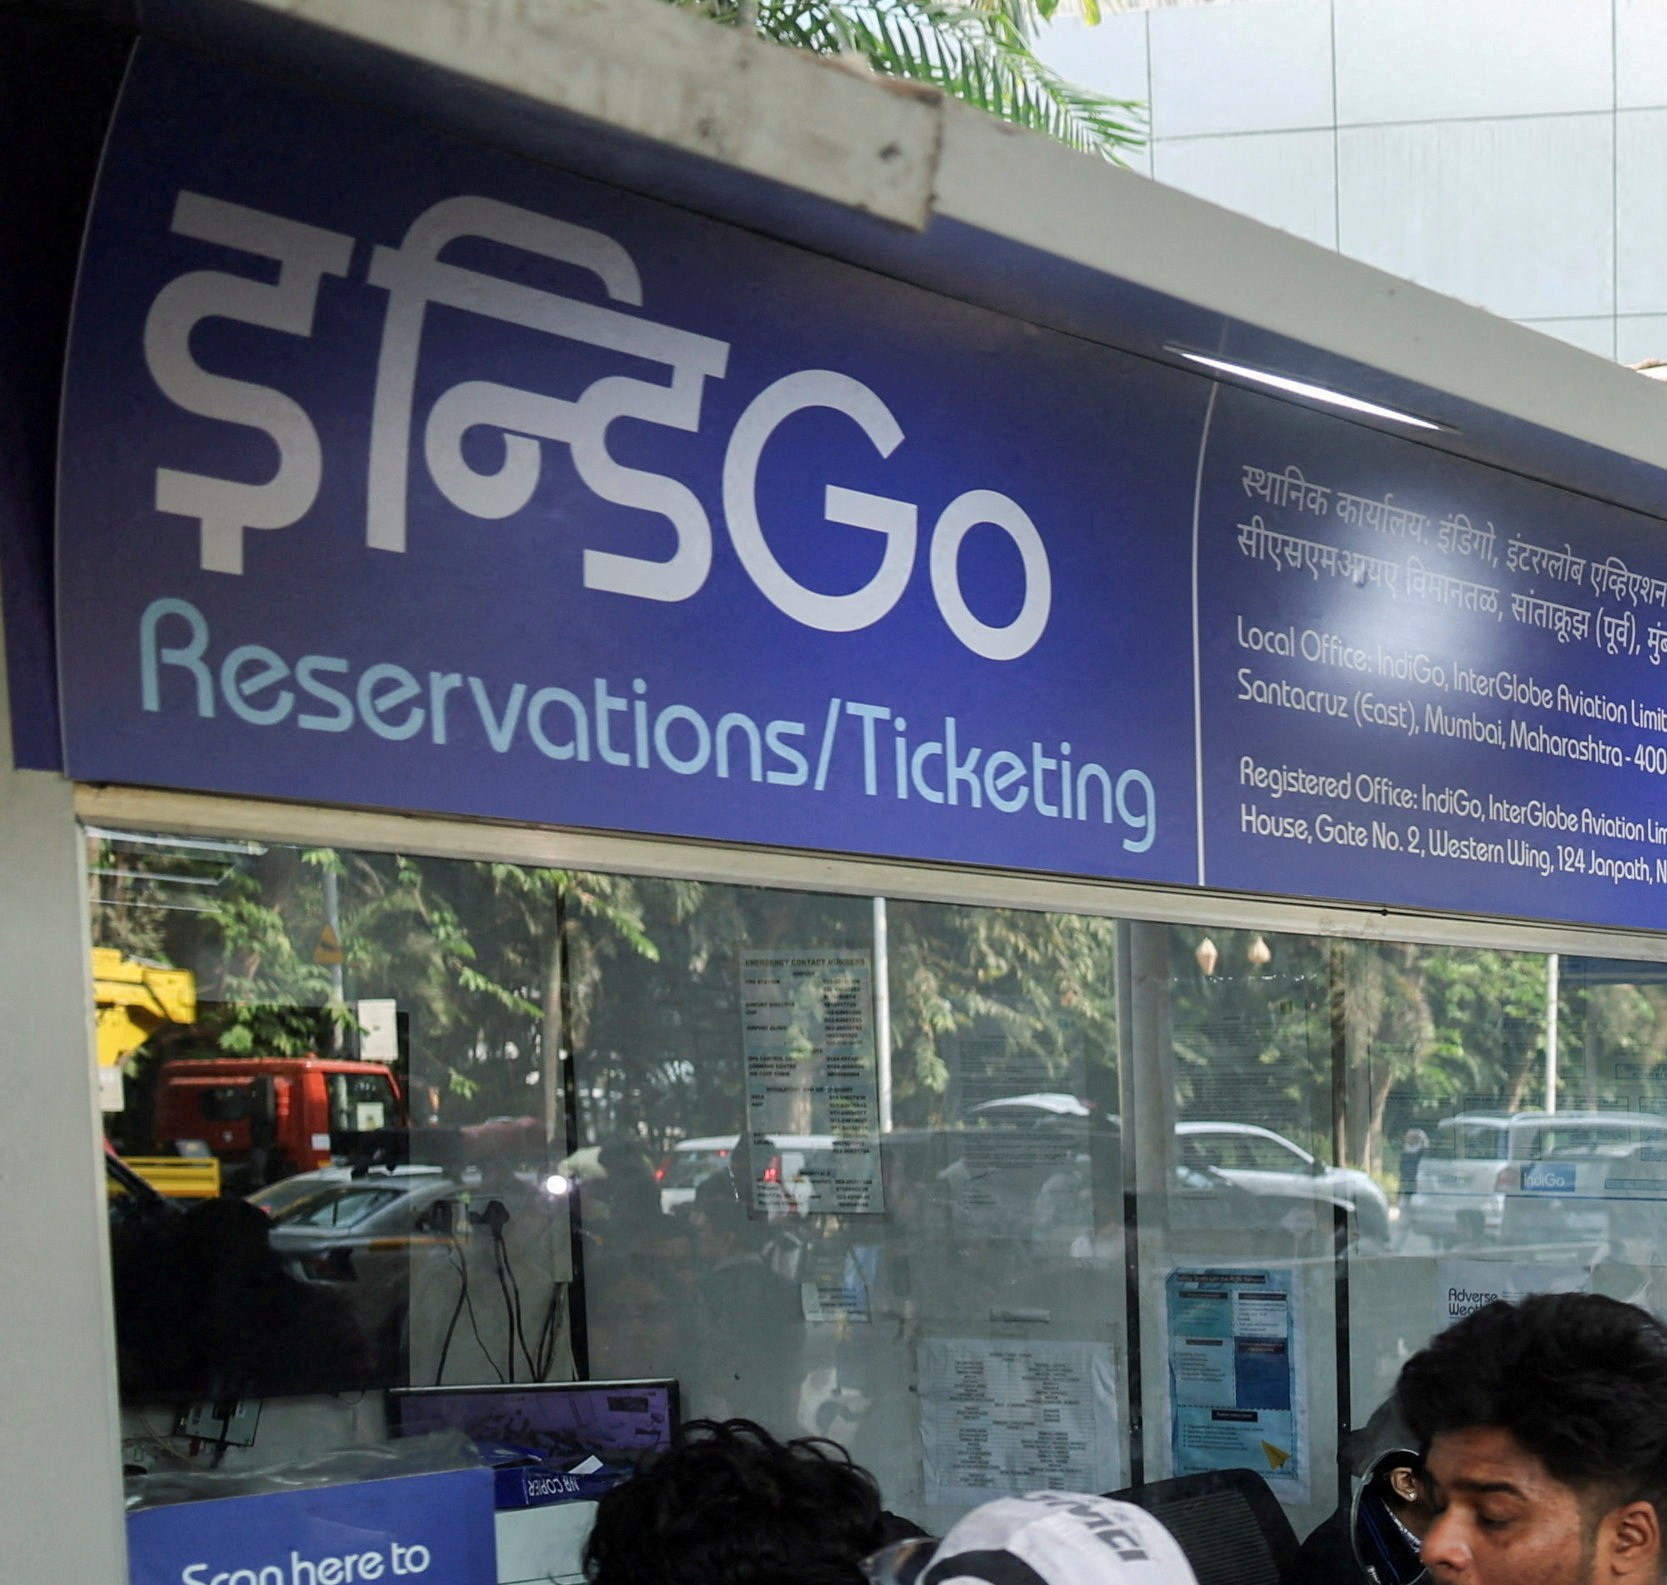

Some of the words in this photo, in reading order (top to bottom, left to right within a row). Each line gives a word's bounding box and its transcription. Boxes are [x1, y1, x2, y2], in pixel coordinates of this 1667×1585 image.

[1242, 464, 1331, 516] स्थानिक
[1237, 615, 1295, 657] Local
[1301, 629, 1373, 673] Office:
[1377, 645, 1448, 692] IndiGo,
[1453, 661, 1554, 709] InterGlobe
[1557, 684, 1627, 725] Aviation
[139, 597, 1158, 855] Reservations/Ticketing
[1237, 668, 1349, 718] Santacruz
[1353, 690, 1419, 736] (East),
[1424, 703, 1506, 750] Mumbai,
[1509, 719, 1623, 768] Maharashtra
[1240, 756, 1351, 800] Registered
[1355, 774, 1418, 810] Office:
[1422, 784, 1486, 823] IndiGo,
[1489, 794, 1578, 833] InterGlobe
[1581, 807, 1644, 843] Aviation
[1240, 803, 1313, 844] House,
[1315, 814, 1368, 848] Gate
[1372, 821, 1404, 852] No.
[1407, 825, 1427, 858] 2,
[1429, 829, 1504, 864] Western
[1507, 839, 1555, 877] Wing,
[1557, 845, 1586, 874] 124
[1588, 850, 1653, 885] Janpath,
[1523, 1172, 1566, 1188] IndiGo
[1448, 1288, 1498, 1302] Adverse
[528, 1478, 564, 1497] COPIER
[391, 1542, 431, 1575] to
